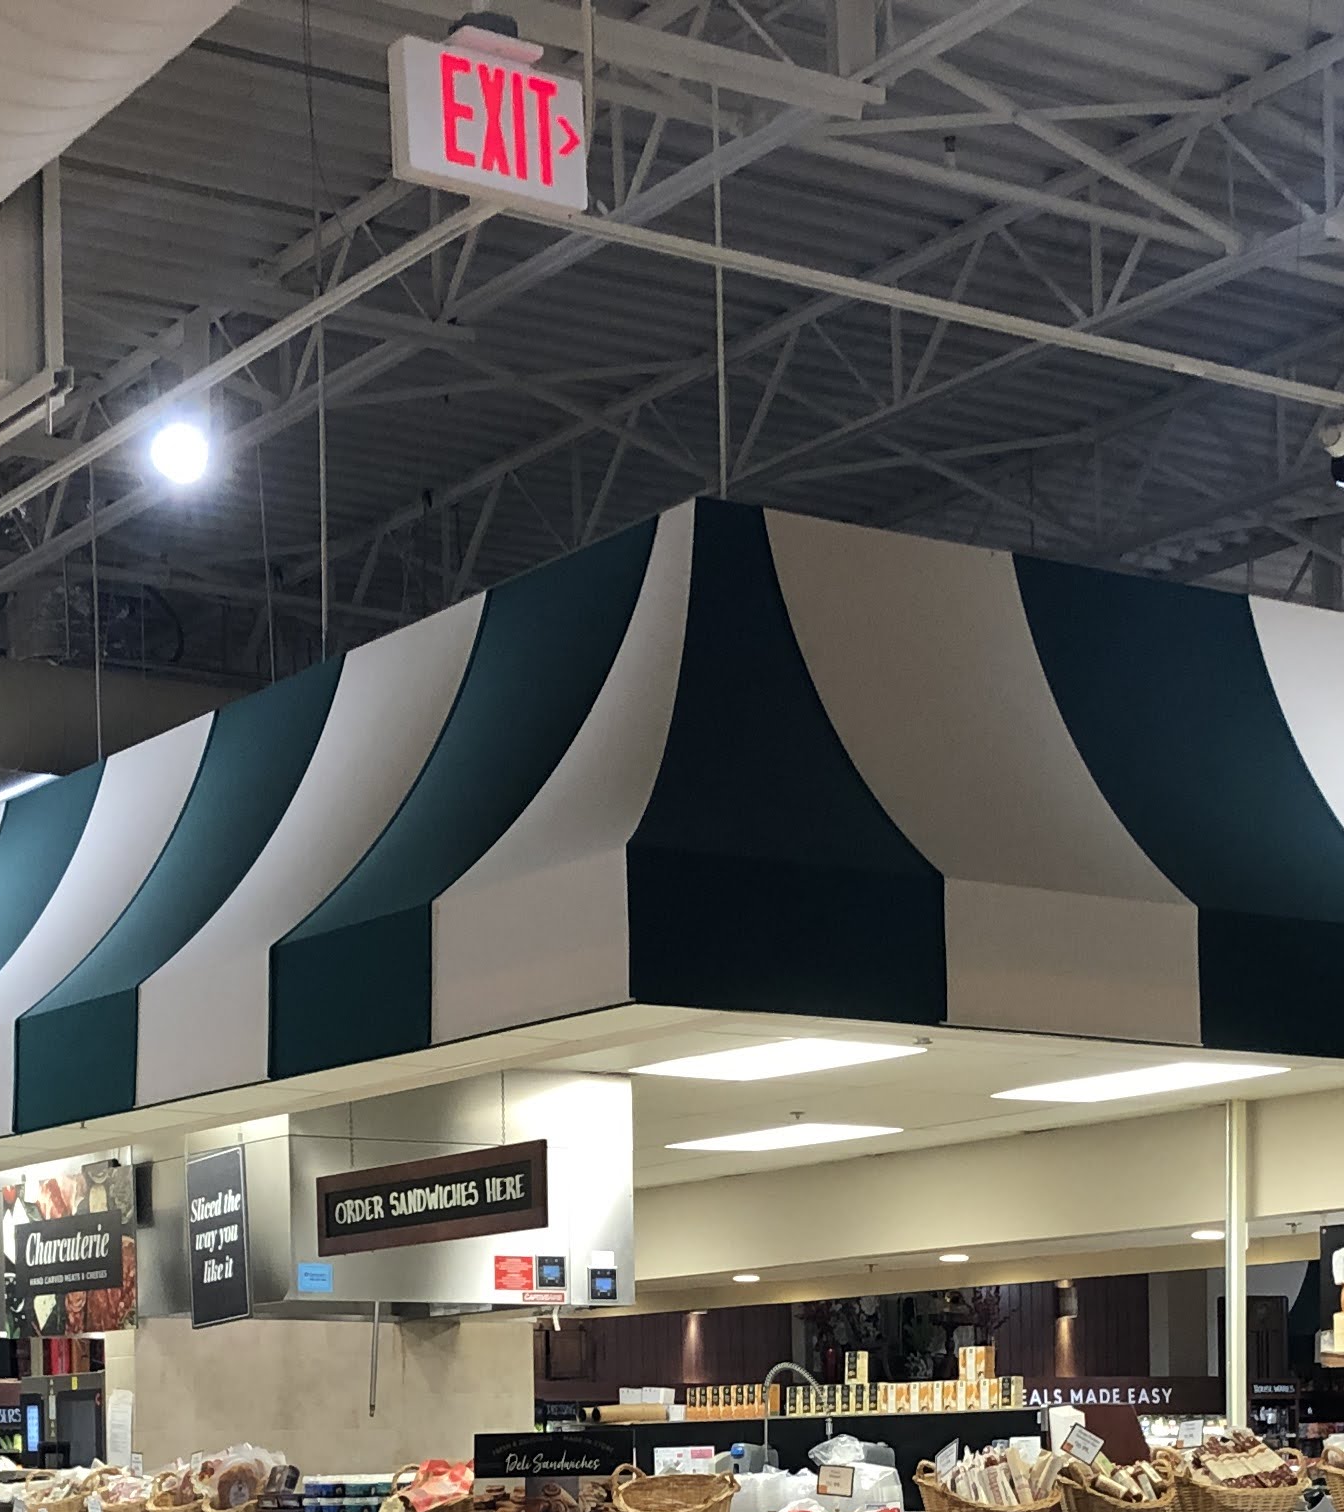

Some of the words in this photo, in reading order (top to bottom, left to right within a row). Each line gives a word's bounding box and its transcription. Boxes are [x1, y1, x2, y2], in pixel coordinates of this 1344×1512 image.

[440, 51, 558, 188] EXIT
[190, 1191, 222, 1223] Sliced
[223, 1189, 241, 1215] the
[334, 1194, 385, 1225] ORDER
[388, 1181, 479, 1217] SANDWICHES
[484, 1173, 525, 1203] HERE
[25, 1223, 110, 1267] Charcuterie
[195, 1229, 218, 1253] way
[218, 1224, 239, 1251] you
[203, 1259, 224, 1284] like
[224, 1255, 234, 1280] it
[1070, 1388, 1121, 1405] MADE
[1127, 1387, 1173, 1405] EASY
[505, 1452, 531, 1474] Deli
[532, 1449, 601, 1474] Sandwiches
